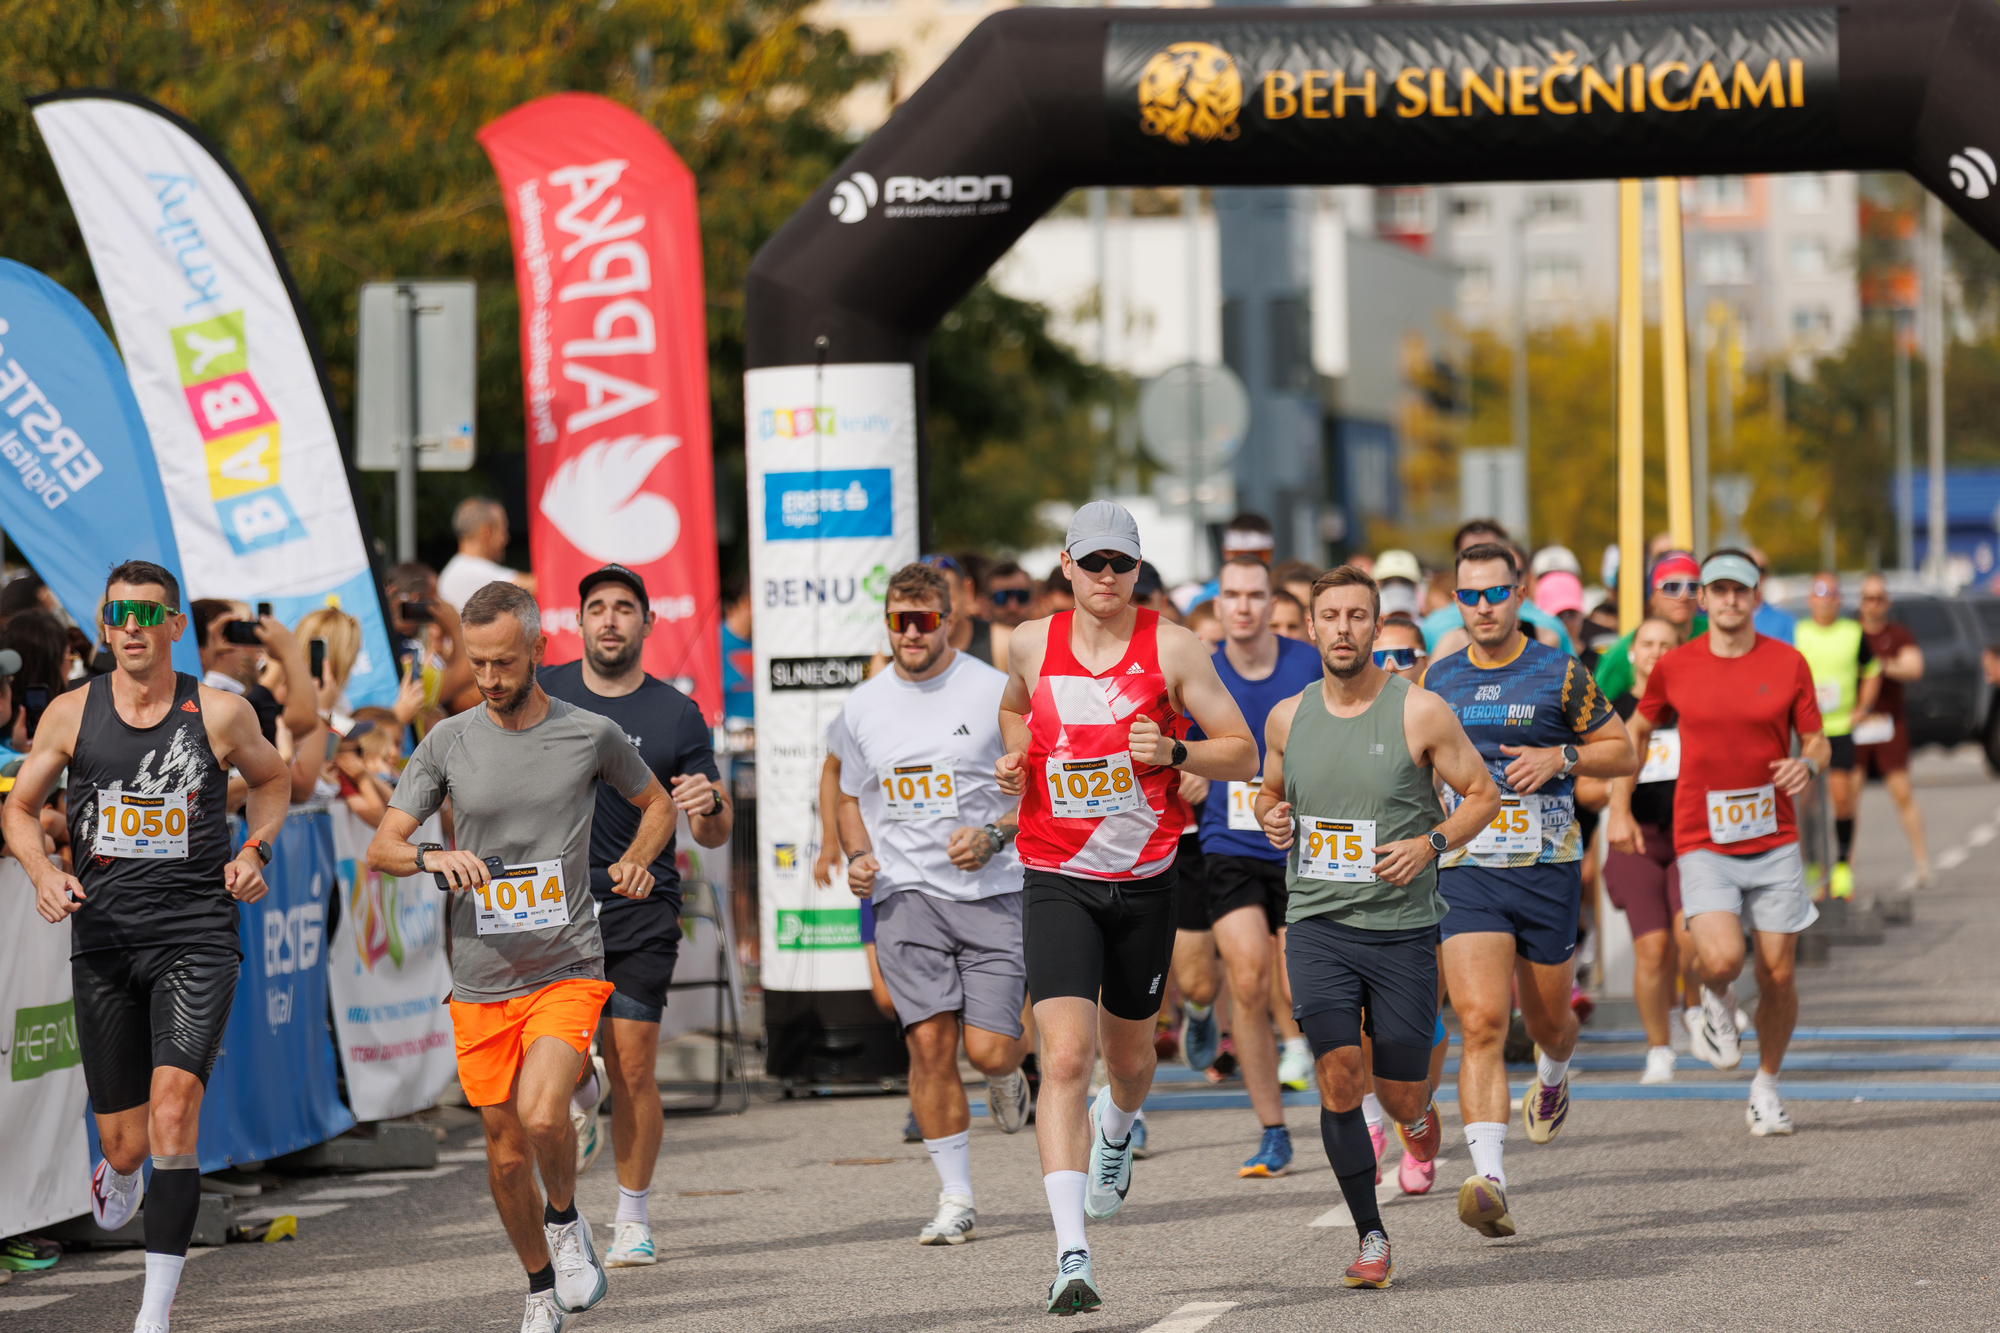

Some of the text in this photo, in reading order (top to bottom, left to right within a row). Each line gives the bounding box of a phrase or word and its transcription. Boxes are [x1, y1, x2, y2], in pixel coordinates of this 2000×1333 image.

[1263, 51, 1804, 119] BEH SLNEČNICAMI
[884, 175, 1013, 203] AXION
[781, 488, 846, 514] ERSTE
[765, 578, 856, 608] BENU
[1478, 684, 1501, 695] ZERO
[883, 774, 953, 801] 1013
[1049, 767, 1132, 798] 1028
[1233, 790, 1259, 811] 10
[1712, 798, 1774, 826] 1012
[101, 806, 186, 837] 1050
[1490, 810, 1529, 834] 45
[1309, 832, 1362, 861] 915
[476, 876, 564, 911] 1014
